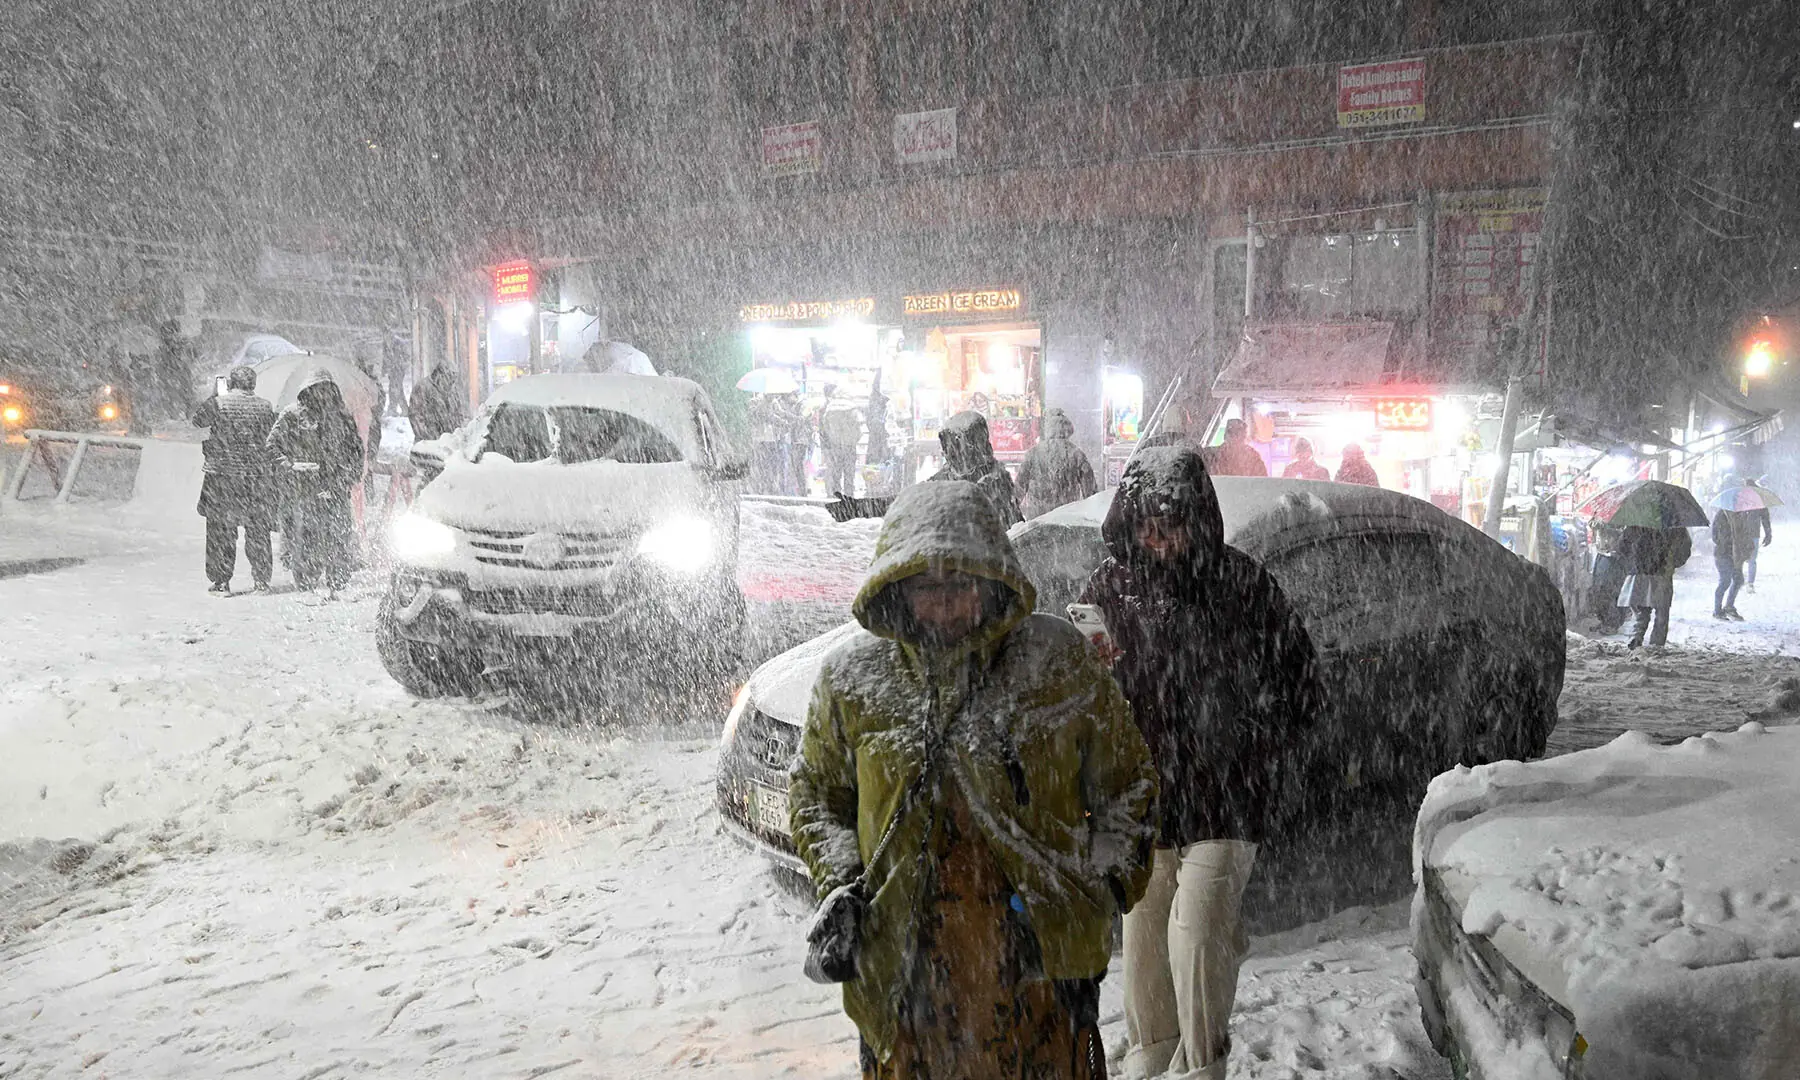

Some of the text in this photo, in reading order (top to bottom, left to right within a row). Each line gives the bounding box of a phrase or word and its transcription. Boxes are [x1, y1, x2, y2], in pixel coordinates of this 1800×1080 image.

[1366, 66, 1422, 85] Ambassador
[1351, 91, 1380, 107] Family
[759, 304, 795, 319] DOLLAR
[806, 302, 841, 318] POUND
[844, 301, 871, 316] SHOP
[903, 291, 1018, 311] TAREEN ICE CREAM
